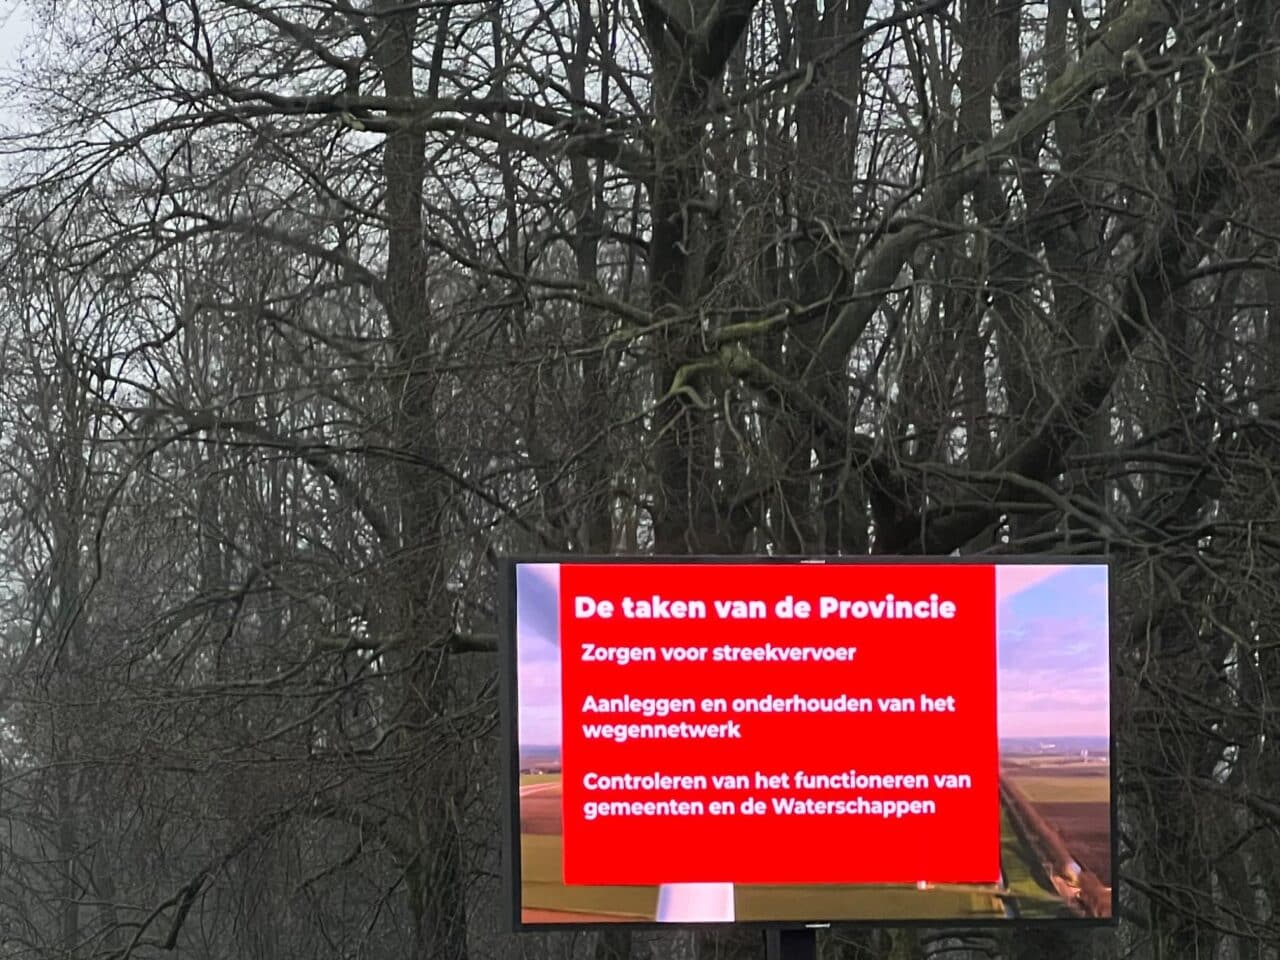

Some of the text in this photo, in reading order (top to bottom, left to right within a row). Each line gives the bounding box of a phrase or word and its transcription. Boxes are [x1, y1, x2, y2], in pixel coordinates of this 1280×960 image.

[575, 593, 957, 619] De taken van de Provincie
[581, 642, 857, 665] Zorgen voor streekvervoer
[581, 694, 956, 717] Aanleggen en onderhouden van het
[582, 719, 741, 743] wegennetwerk
[583, 769, 972, 791] Controleren van het functioneren van
[583, 796, 936, 820] gemeenten en de Waterschappen
